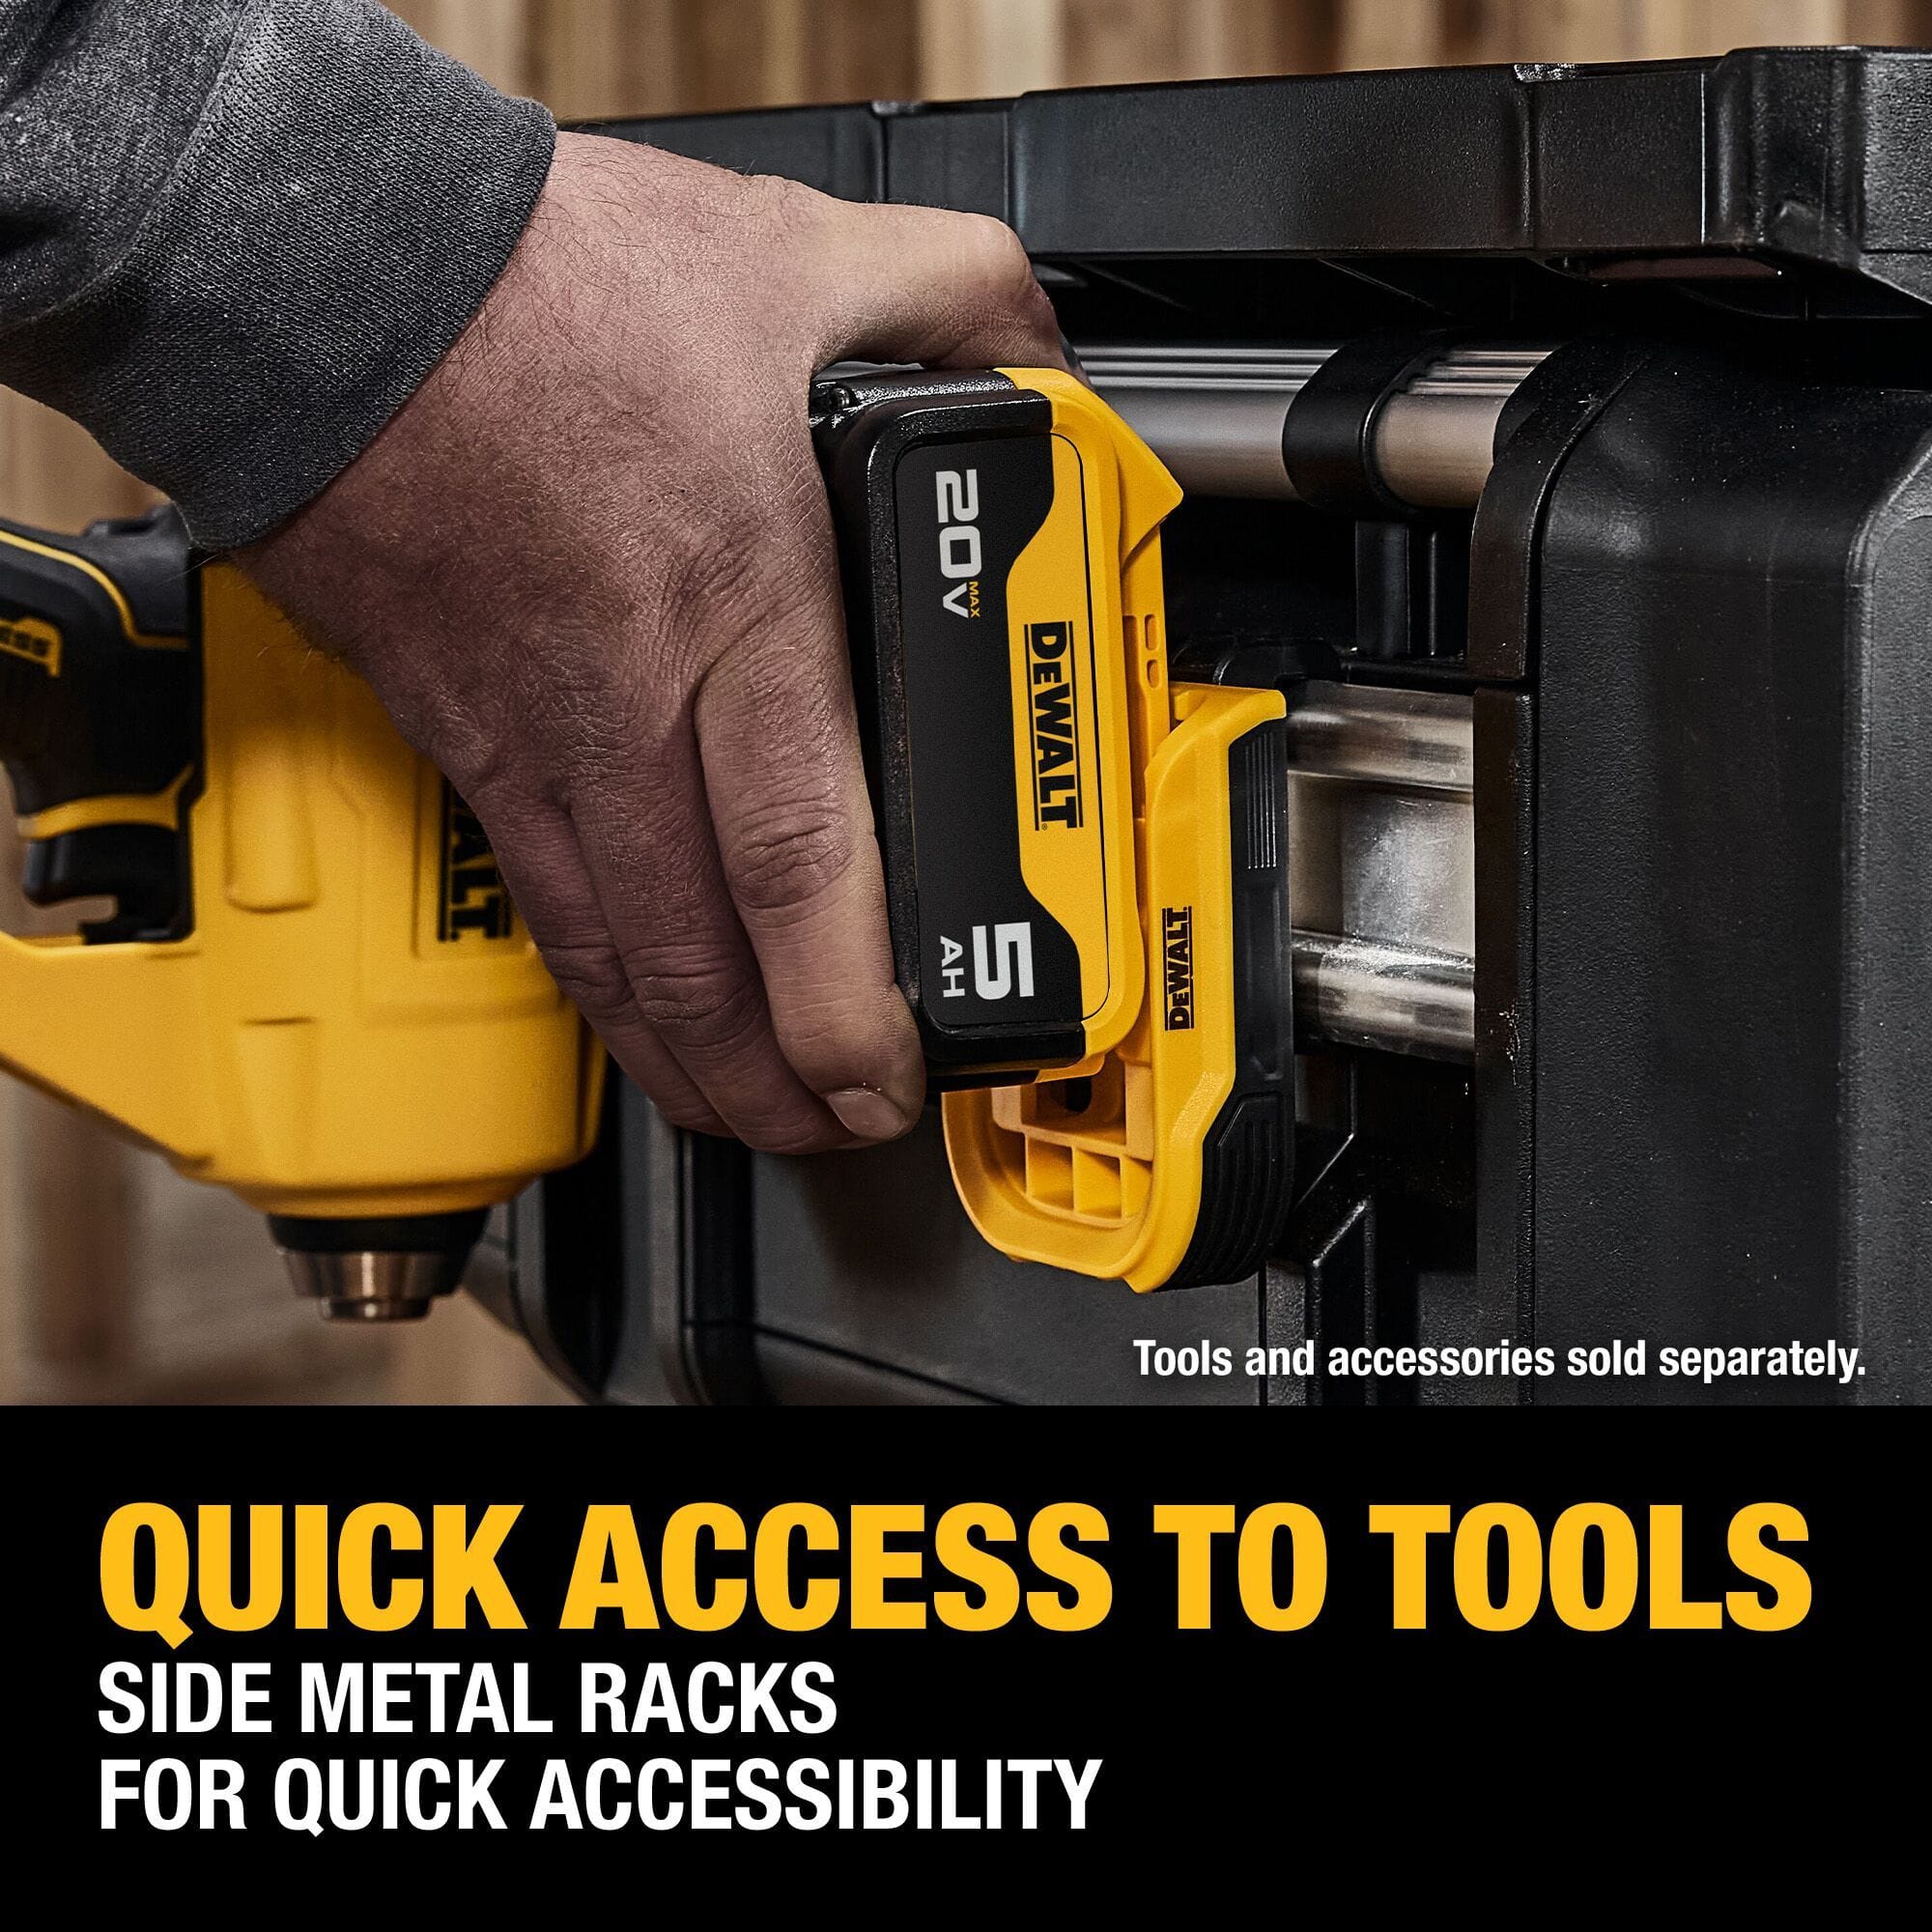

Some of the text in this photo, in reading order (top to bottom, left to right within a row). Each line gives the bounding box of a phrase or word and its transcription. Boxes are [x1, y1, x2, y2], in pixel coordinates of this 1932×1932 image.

[935, 469, 982, 618] 20V MAX
[940, 935, 965, 998] AH
[972, 922, 1035, 1000] 5
